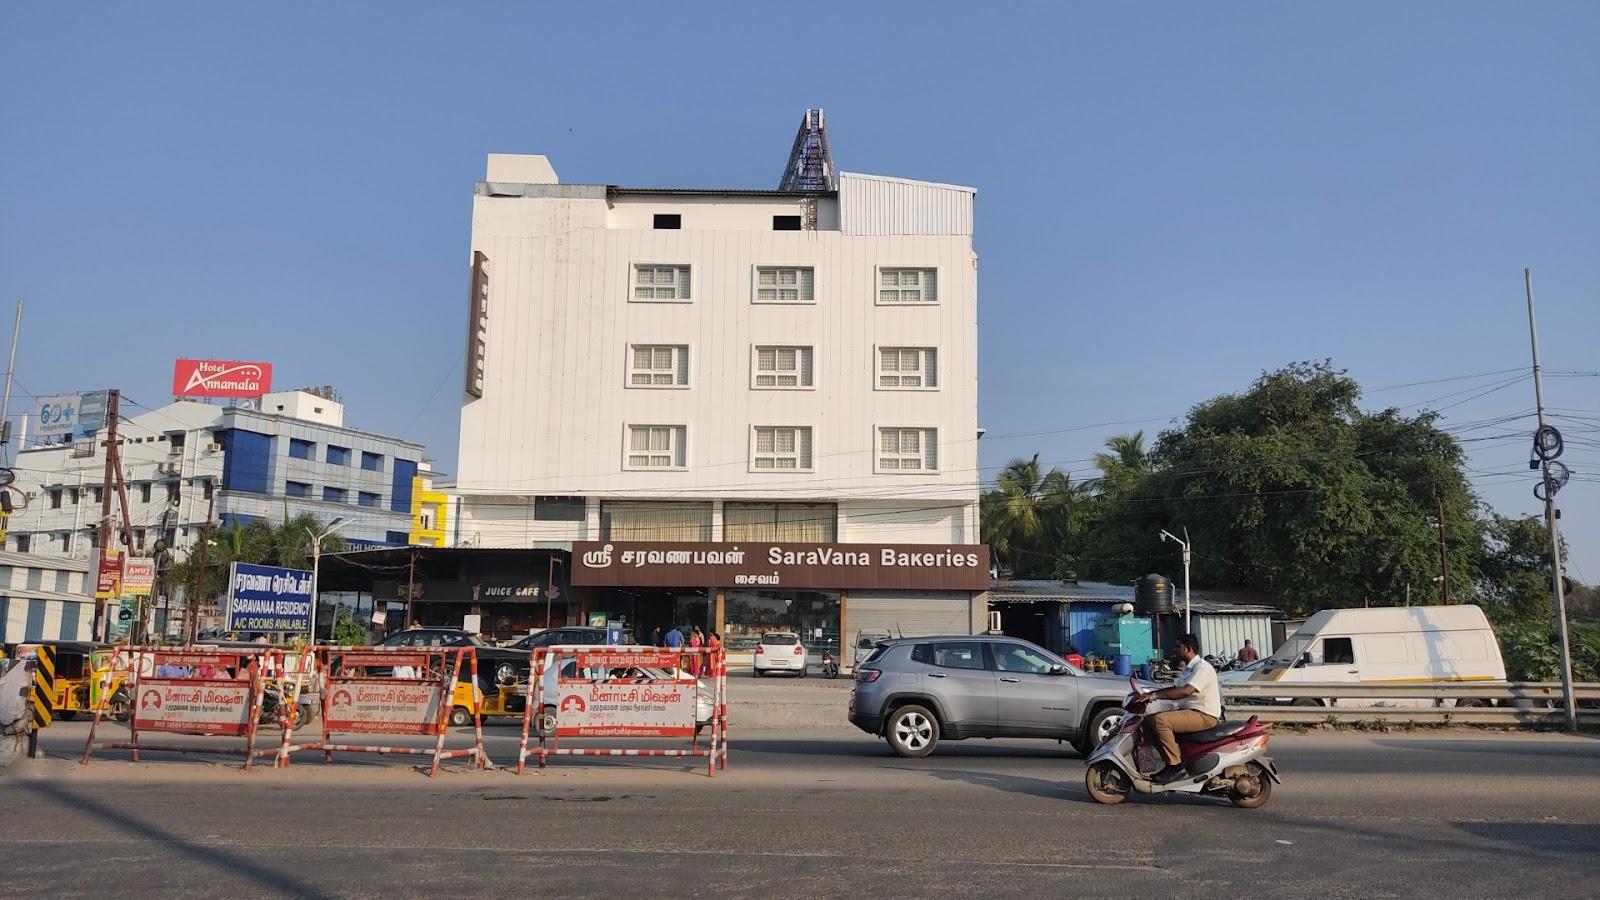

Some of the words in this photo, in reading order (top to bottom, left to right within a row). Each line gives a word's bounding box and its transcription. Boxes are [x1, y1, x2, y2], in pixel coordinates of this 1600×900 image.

[199, 362, 225, 372] Hotel
[183, 368, 259, 393] Annamalai
[583, 544, 614, 568] ஸ்ரீ
[620, 546, 745, 568] சரவணபவன்
[768, 547, 870, 566] SaraVana
[881, 549, 978, 567] Bakeries
[235, 573, 273, 593] சரவணா
[734, 571, 780, 585] சைவம்
[485, 587, 512, 597] JUICE
[515, 587, 540, 597] CAFE
[233, 598, 275, 615] SARAVANAA
[275, 601, 311, 616] RESIDENCY
[234, 617, 247, 629] A/C
[248, 617, 274, 630] ROOMS
[274, 619, 307, 630] AVAILABLE
[165, 688, 203, 703] மீனாட்சி
[357, 687, 395, 704] மீனாட்சி
[589, 686, 639, 703] மீனாட்சி
